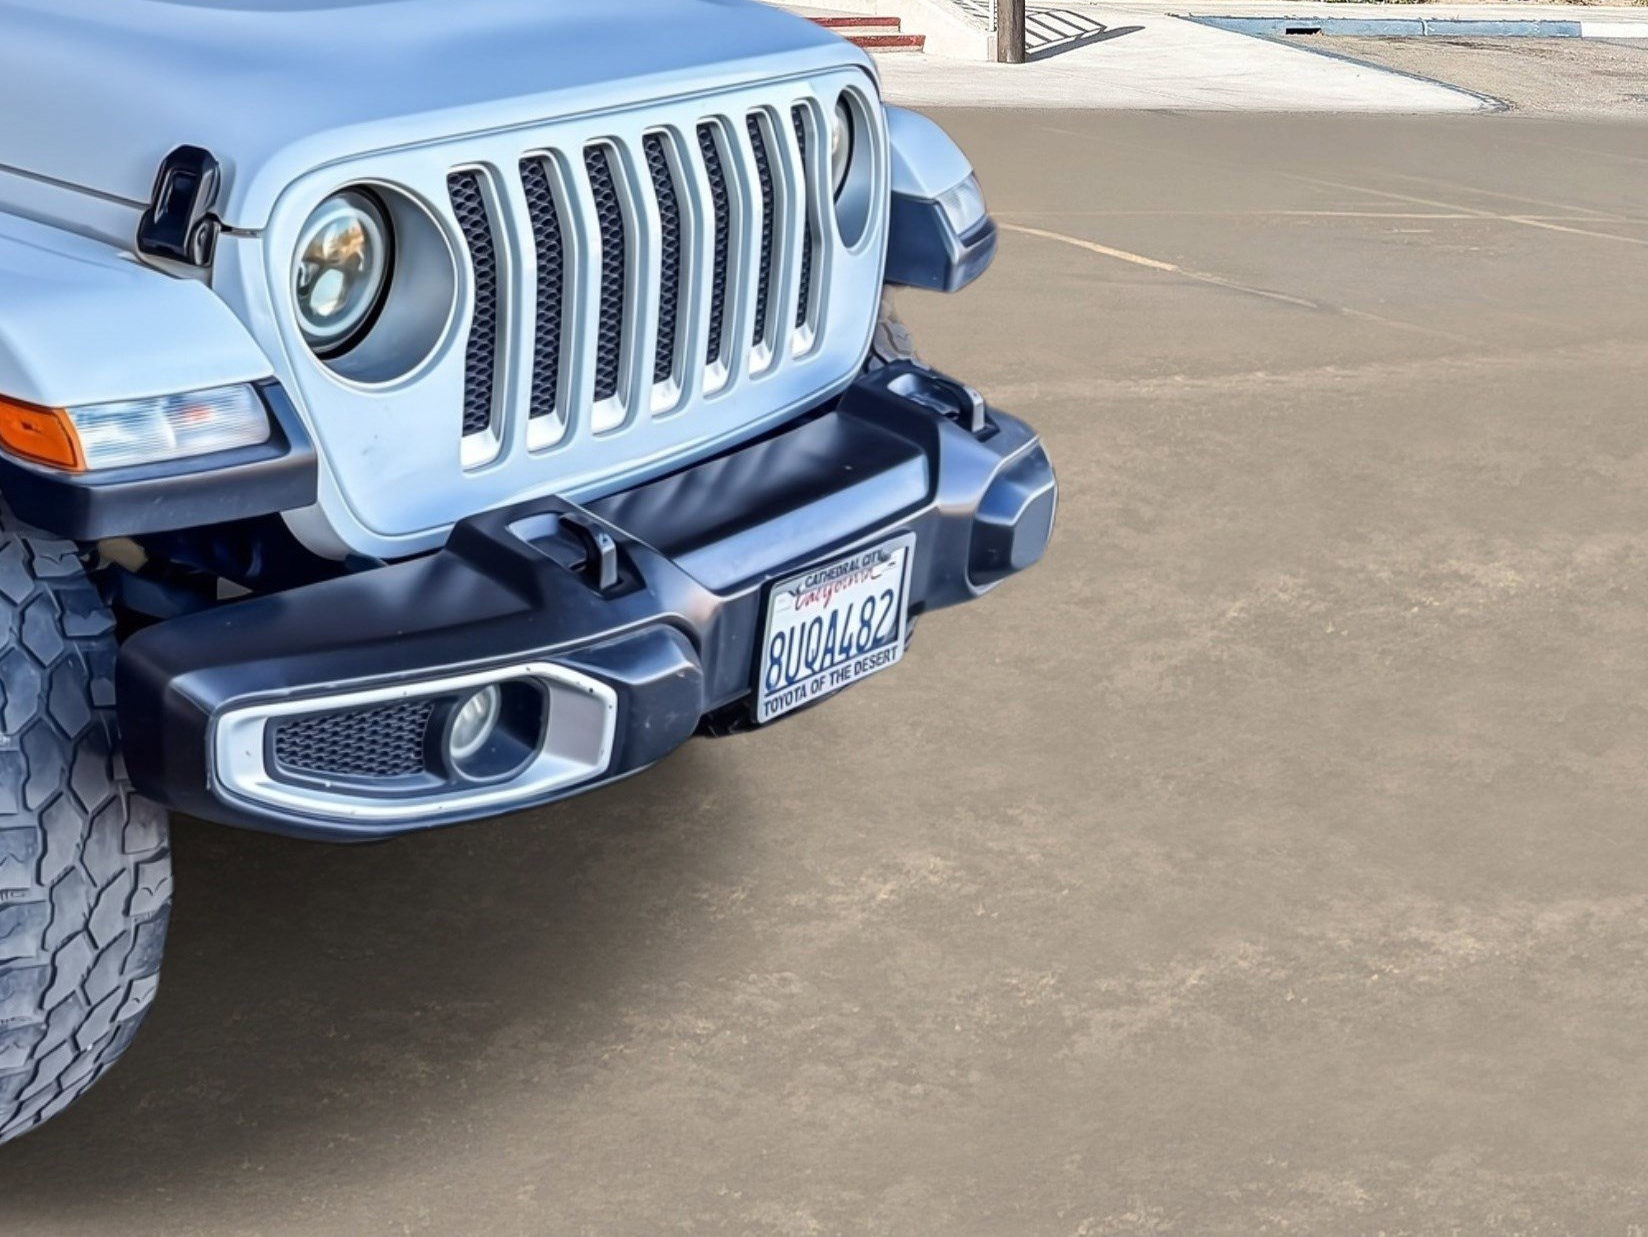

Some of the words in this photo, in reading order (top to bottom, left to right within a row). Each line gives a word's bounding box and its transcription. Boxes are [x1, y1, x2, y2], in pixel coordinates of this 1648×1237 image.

[805, 558, 860, 588] CATHEDRAL
[765, 588, 894, 692] 8UQA482
[764, 687, 807, 716] TOYOTA
[810, 677, 825, 695] OF
[830, 666, 852, 687] THE
[854, 647, 898, 675] DESERT
